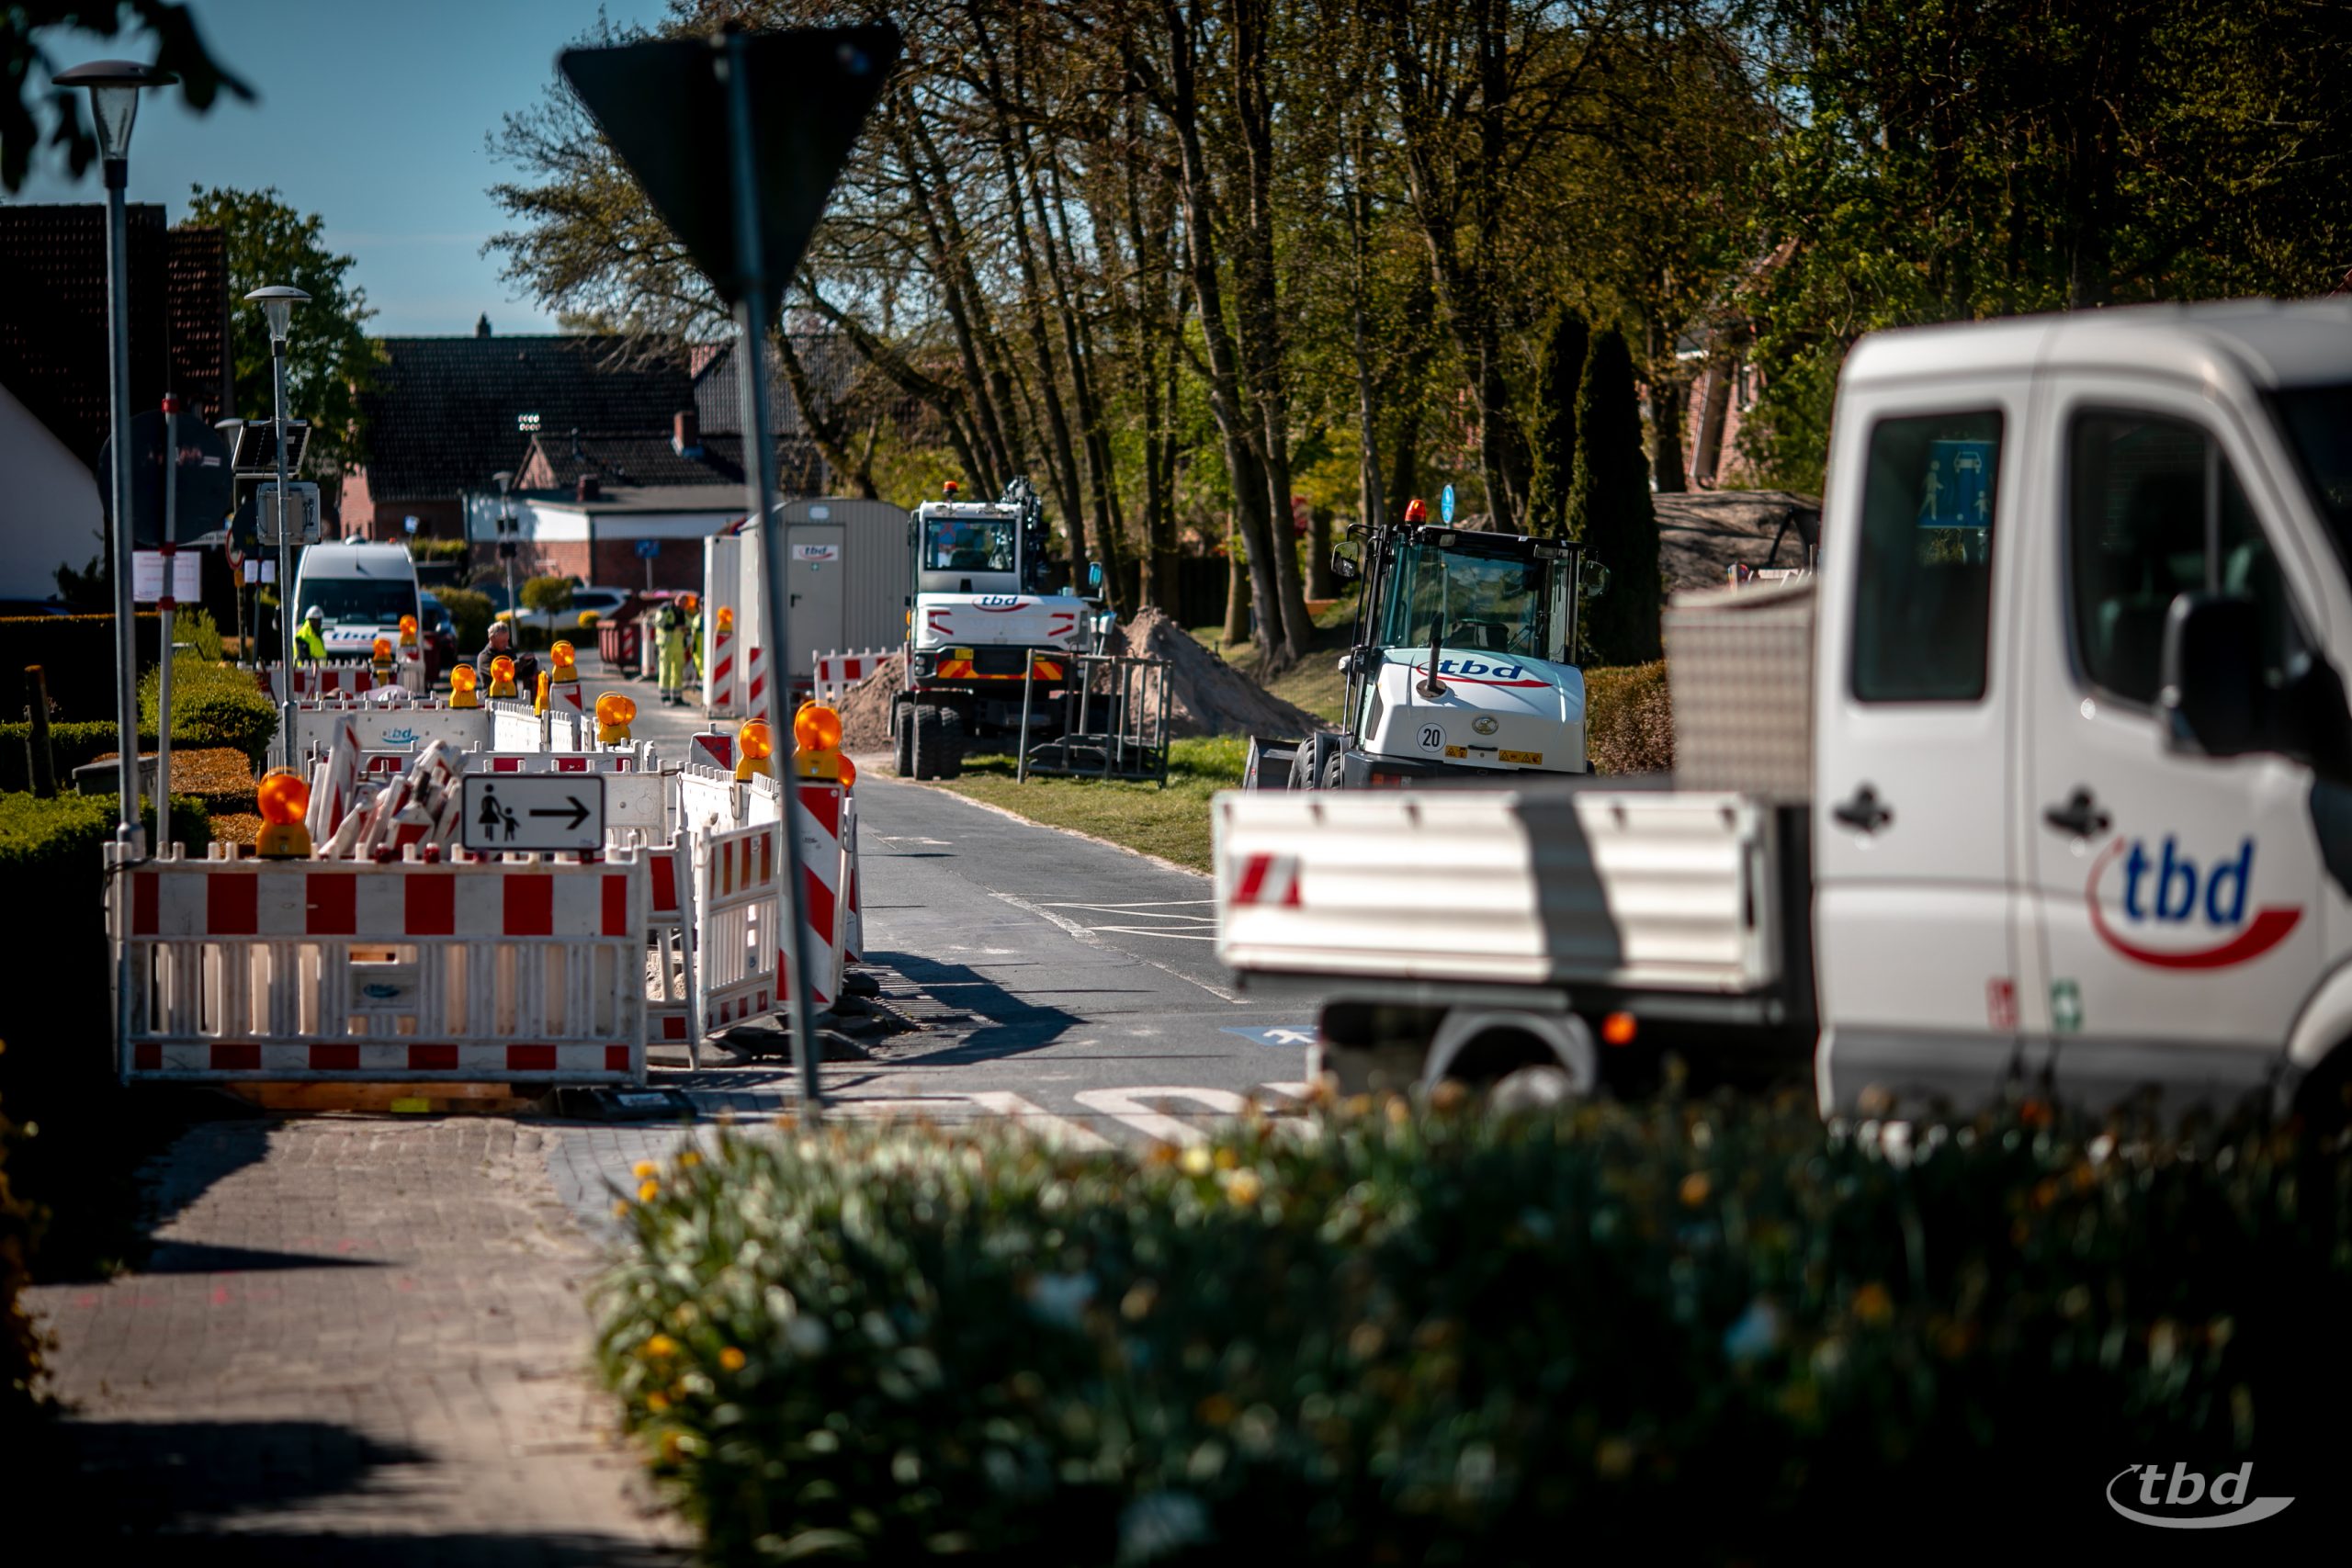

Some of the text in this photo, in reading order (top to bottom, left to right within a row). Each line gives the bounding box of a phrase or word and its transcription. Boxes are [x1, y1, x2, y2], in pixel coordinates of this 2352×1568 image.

[981, 596, 1018, 606] tbd
[1439, 660, 1523, 680] tbd
[1422, 728, 1441, 748] 20
[2124, 835, 2254, 925] tbd
